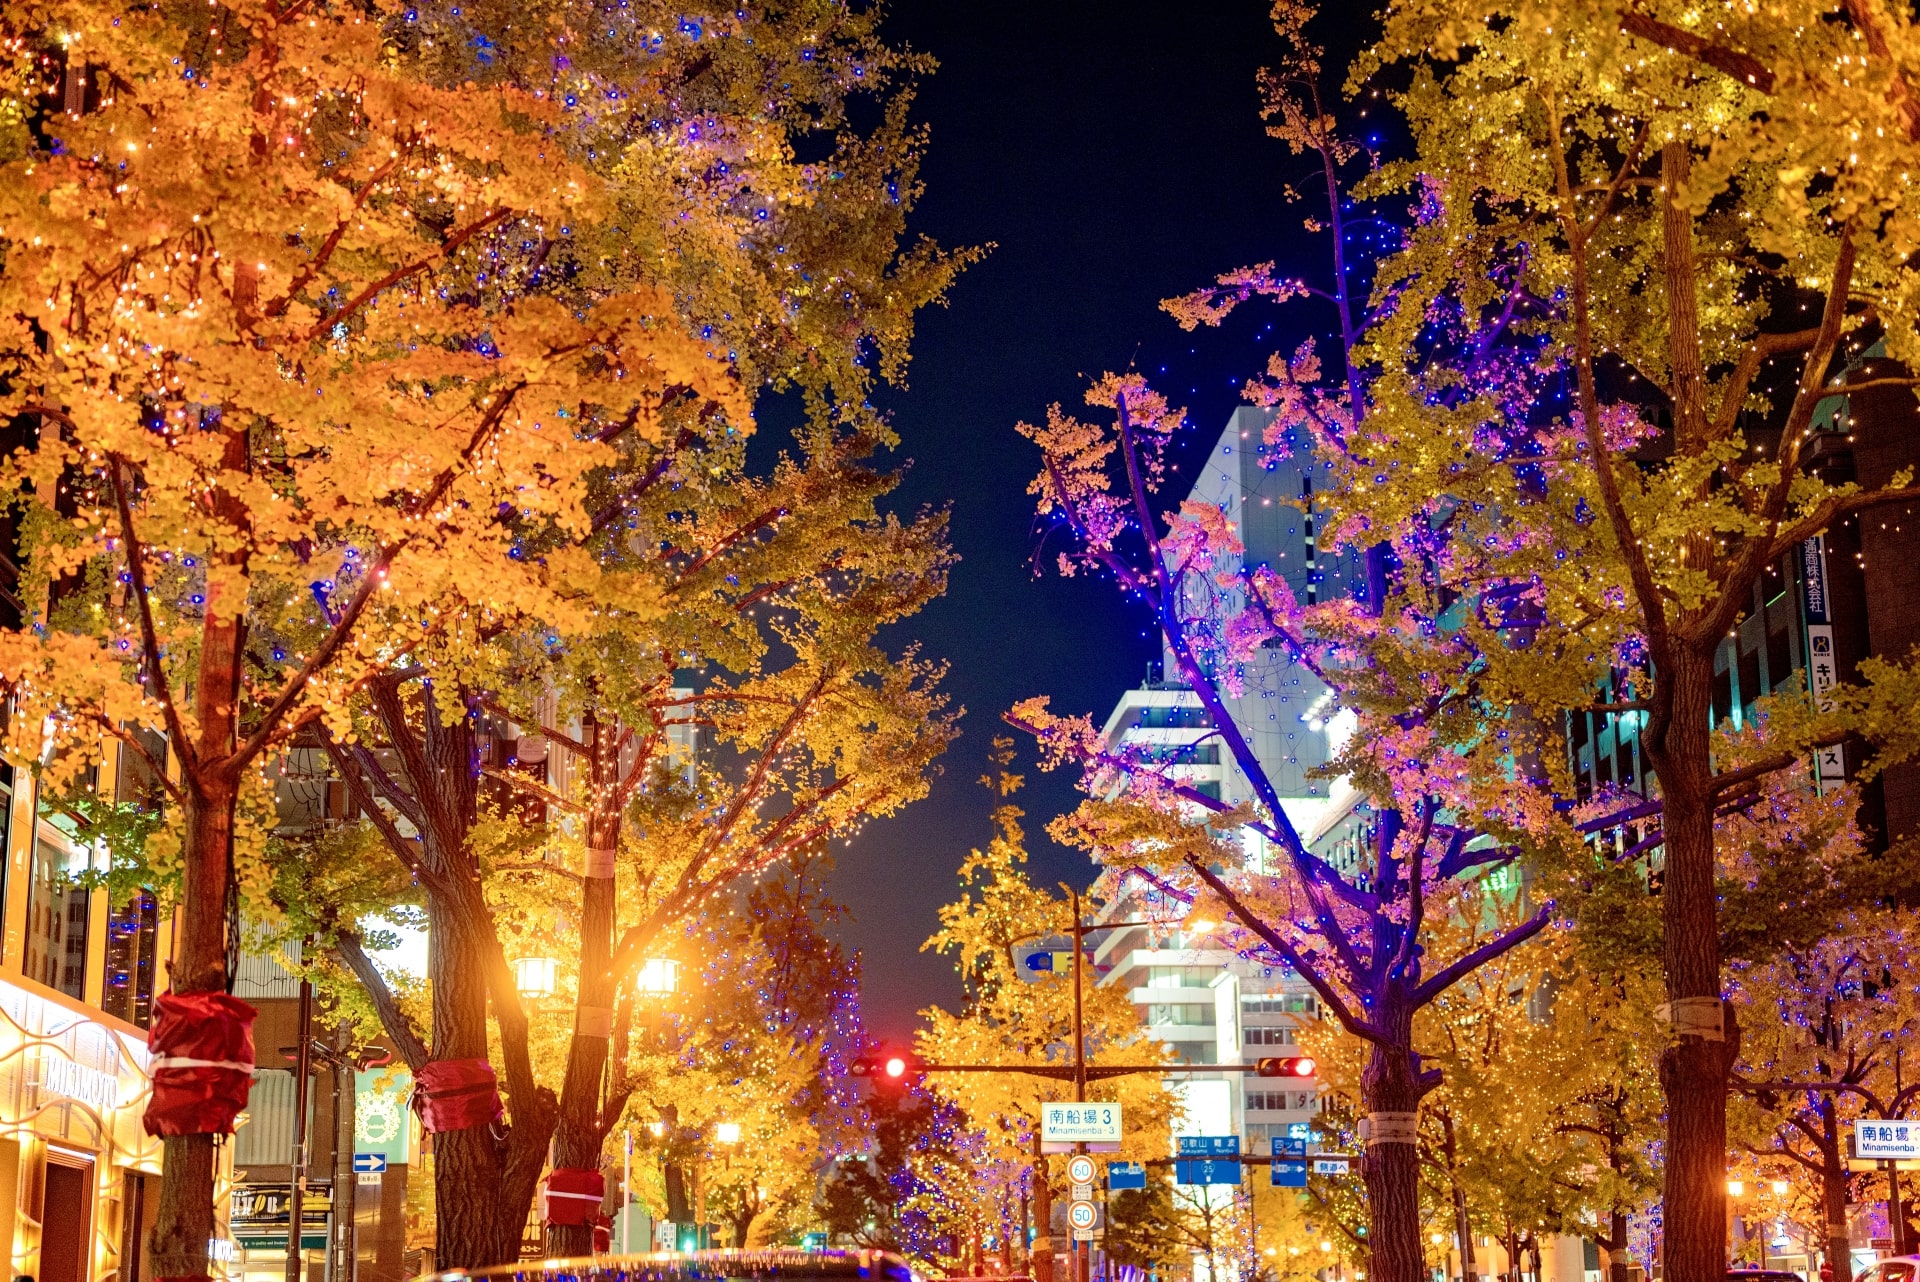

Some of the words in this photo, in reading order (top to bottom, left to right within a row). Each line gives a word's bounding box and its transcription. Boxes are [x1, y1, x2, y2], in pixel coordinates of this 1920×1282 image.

[1049, 1109, 1097, 1124] 南船場
[1102, 1109, 1111, 1125] 3
[1049, 1126, 1102, 1135] Minamisenba
[1109, 1126, 1115, 1135] 3
[1862, 1126, 1909, 1141] 南船場
[1862, 1143, 1915, 1152] Minamisenba
[1074, 1164, 1089, 1177] 60
[1203, 1165, 1213, 1173] 25
[231, 1195, 278, 1214] UTOR
[1074, 1209, 1090, 1222] 50
